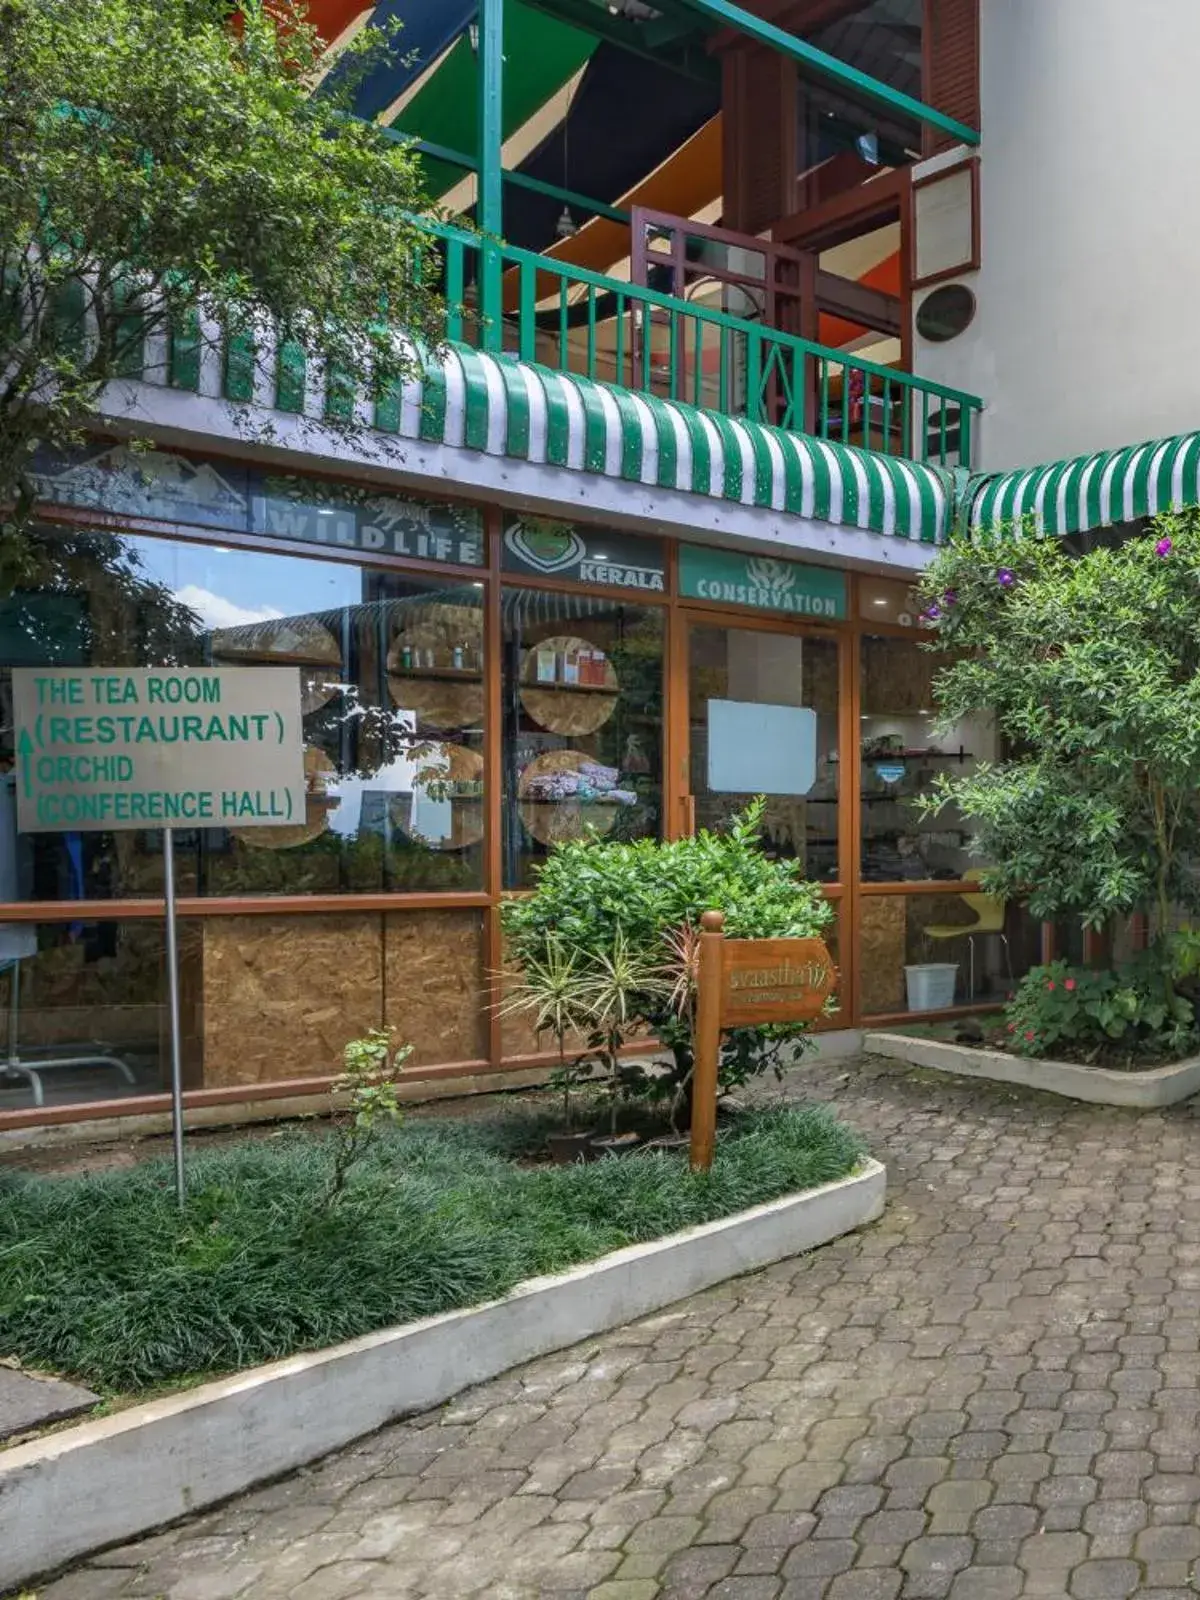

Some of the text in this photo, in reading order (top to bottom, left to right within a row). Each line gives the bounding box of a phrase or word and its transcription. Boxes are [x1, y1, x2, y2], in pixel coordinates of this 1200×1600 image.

[269, 508, 478, 565] WILDLIFE
[580, 563, 664, 591] KERALA
[697, 578, 836, 616] CONSERVATION
[34, 676, 221, 704] THE TEA ROOM
[35, 711, 285, 748] (RESTAURANT)
[36, 755, 133, 783] ORCHID
[36, 787, 292, 824] (CONFERENCE HALL)
